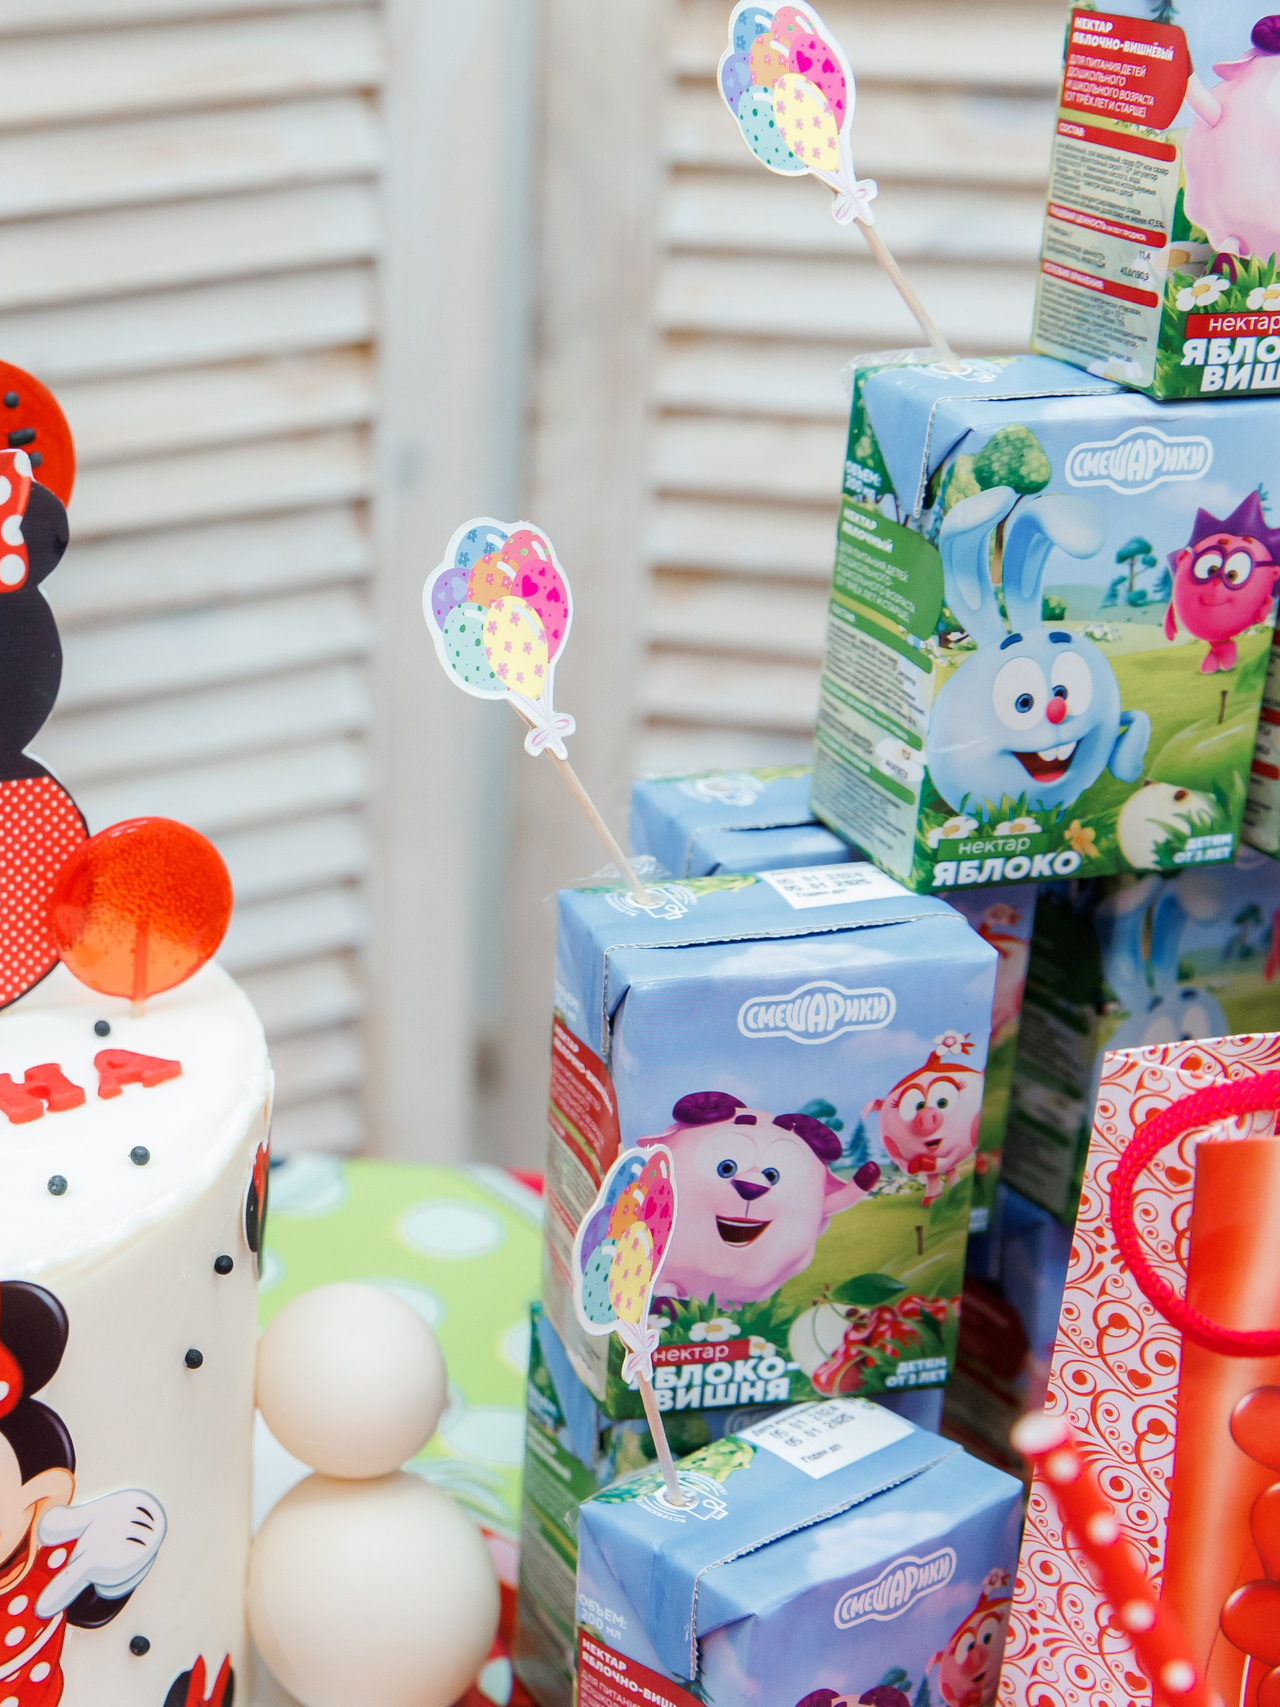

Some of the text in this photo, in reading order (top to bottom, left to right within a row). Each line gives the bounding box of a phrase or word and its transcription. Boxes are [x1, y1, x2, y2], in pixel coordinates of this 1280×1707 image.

[1074, 17, 1112, 32] НЕКТАР
[1121, 64, 1146, 77] ДЕТЕЙ
[1119, 89, 1154, 106] ВОЗРАСТА
[1209, 315, 1280, 334] нектар
[1073, 438, 1205, 482] СМЕШАРИКИ
[958, 836, 1031, 855] нектар
[931, 850, 1081, 887] ЯБЛОКО
[747, 992, 887, 1034] СМЕШАРИКИ
[652, 1344, 729, 1363] нектар
[628, 1356, 800, 1391] БЛОКО-
[841, 1554, 950, 1620] СМЕШАРИКИ
[579, 1594, 627, 1630] ОБЪЕМ:
[581, 1608, 622, 1640] 200 мл
[582, 1638, 627, 1671] НЕКТАР
